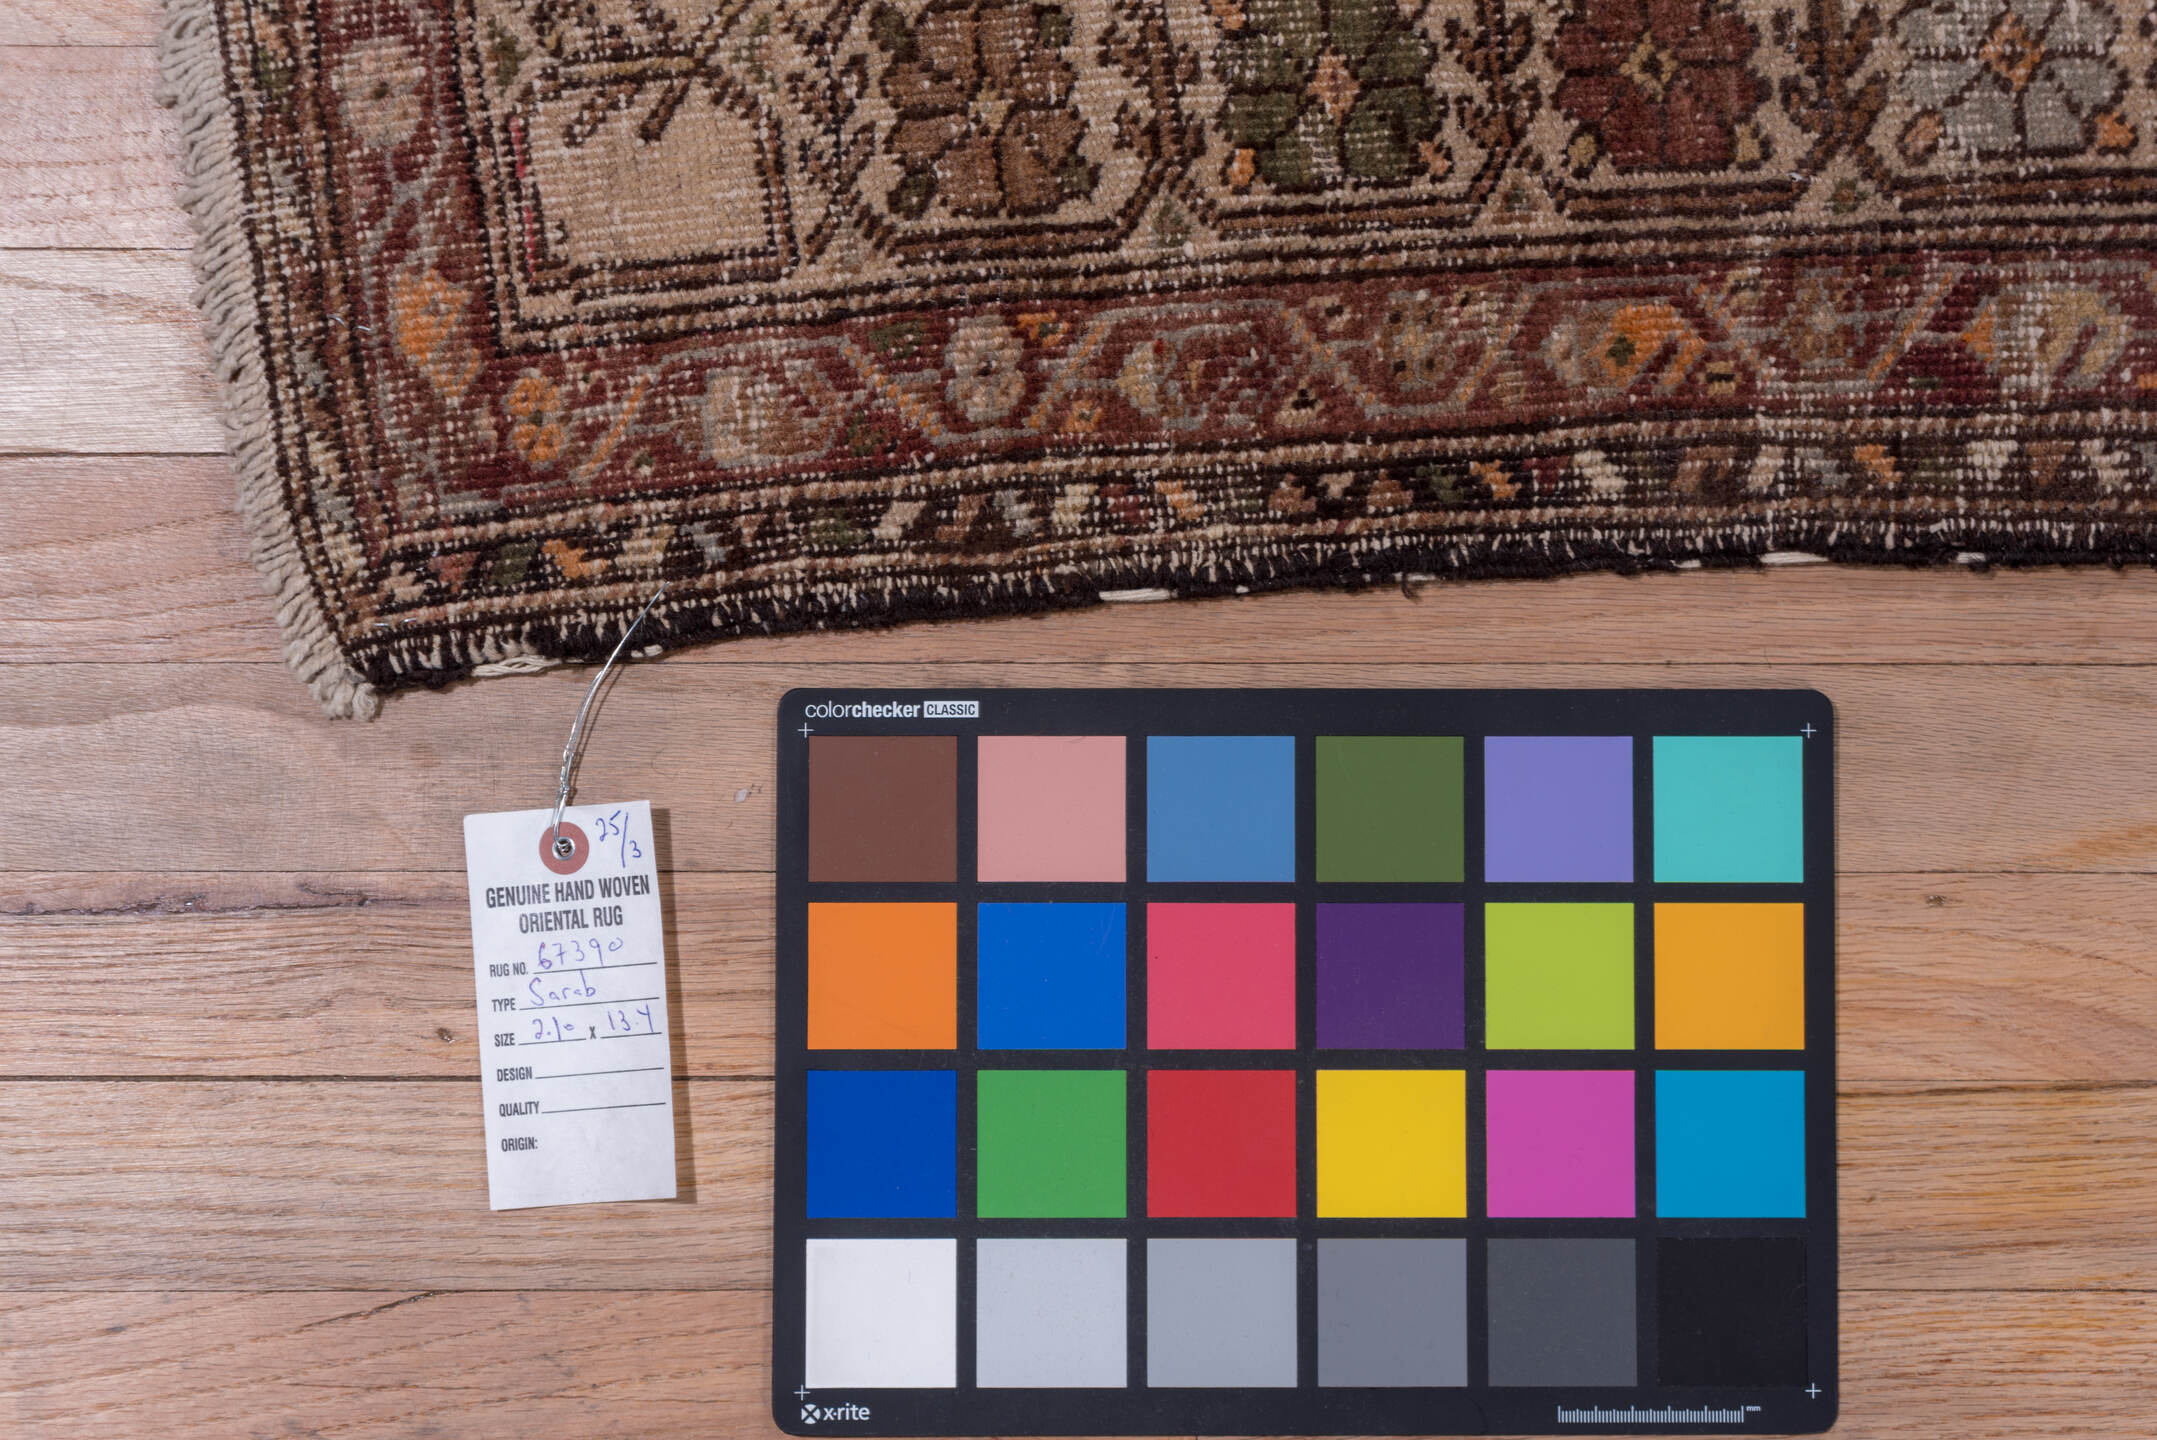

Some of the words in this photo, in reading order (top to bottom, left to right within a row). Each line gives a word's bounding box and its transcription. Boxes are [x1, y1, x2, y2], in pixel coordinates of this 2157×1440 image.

[805, 700, 920, 718] colorchecker
[926, 703, 977, 716] CLASSIC
[486, 883, 551, 908] GENUINE
[555, 879, 595, 902] HAND
[598, 874, 650, 898] WOVEN
[519, 911, 589, 934] ORIENTAL
[593, 905, 624, 927] RUG
[538, 937, 624, 970] 67390
[489, 964, 510, 977] RUG
[512, 961, 528, 976] NO.
[492, 998, 516, 1012] TYPE
[494, 1033, 515, 1047] SIZE
[496, 1066, 533, 1082] DESIGN
[498, 1101, 540, 1118] QUALITY
[501, 1136, 538, 1152] ORIGIN:
